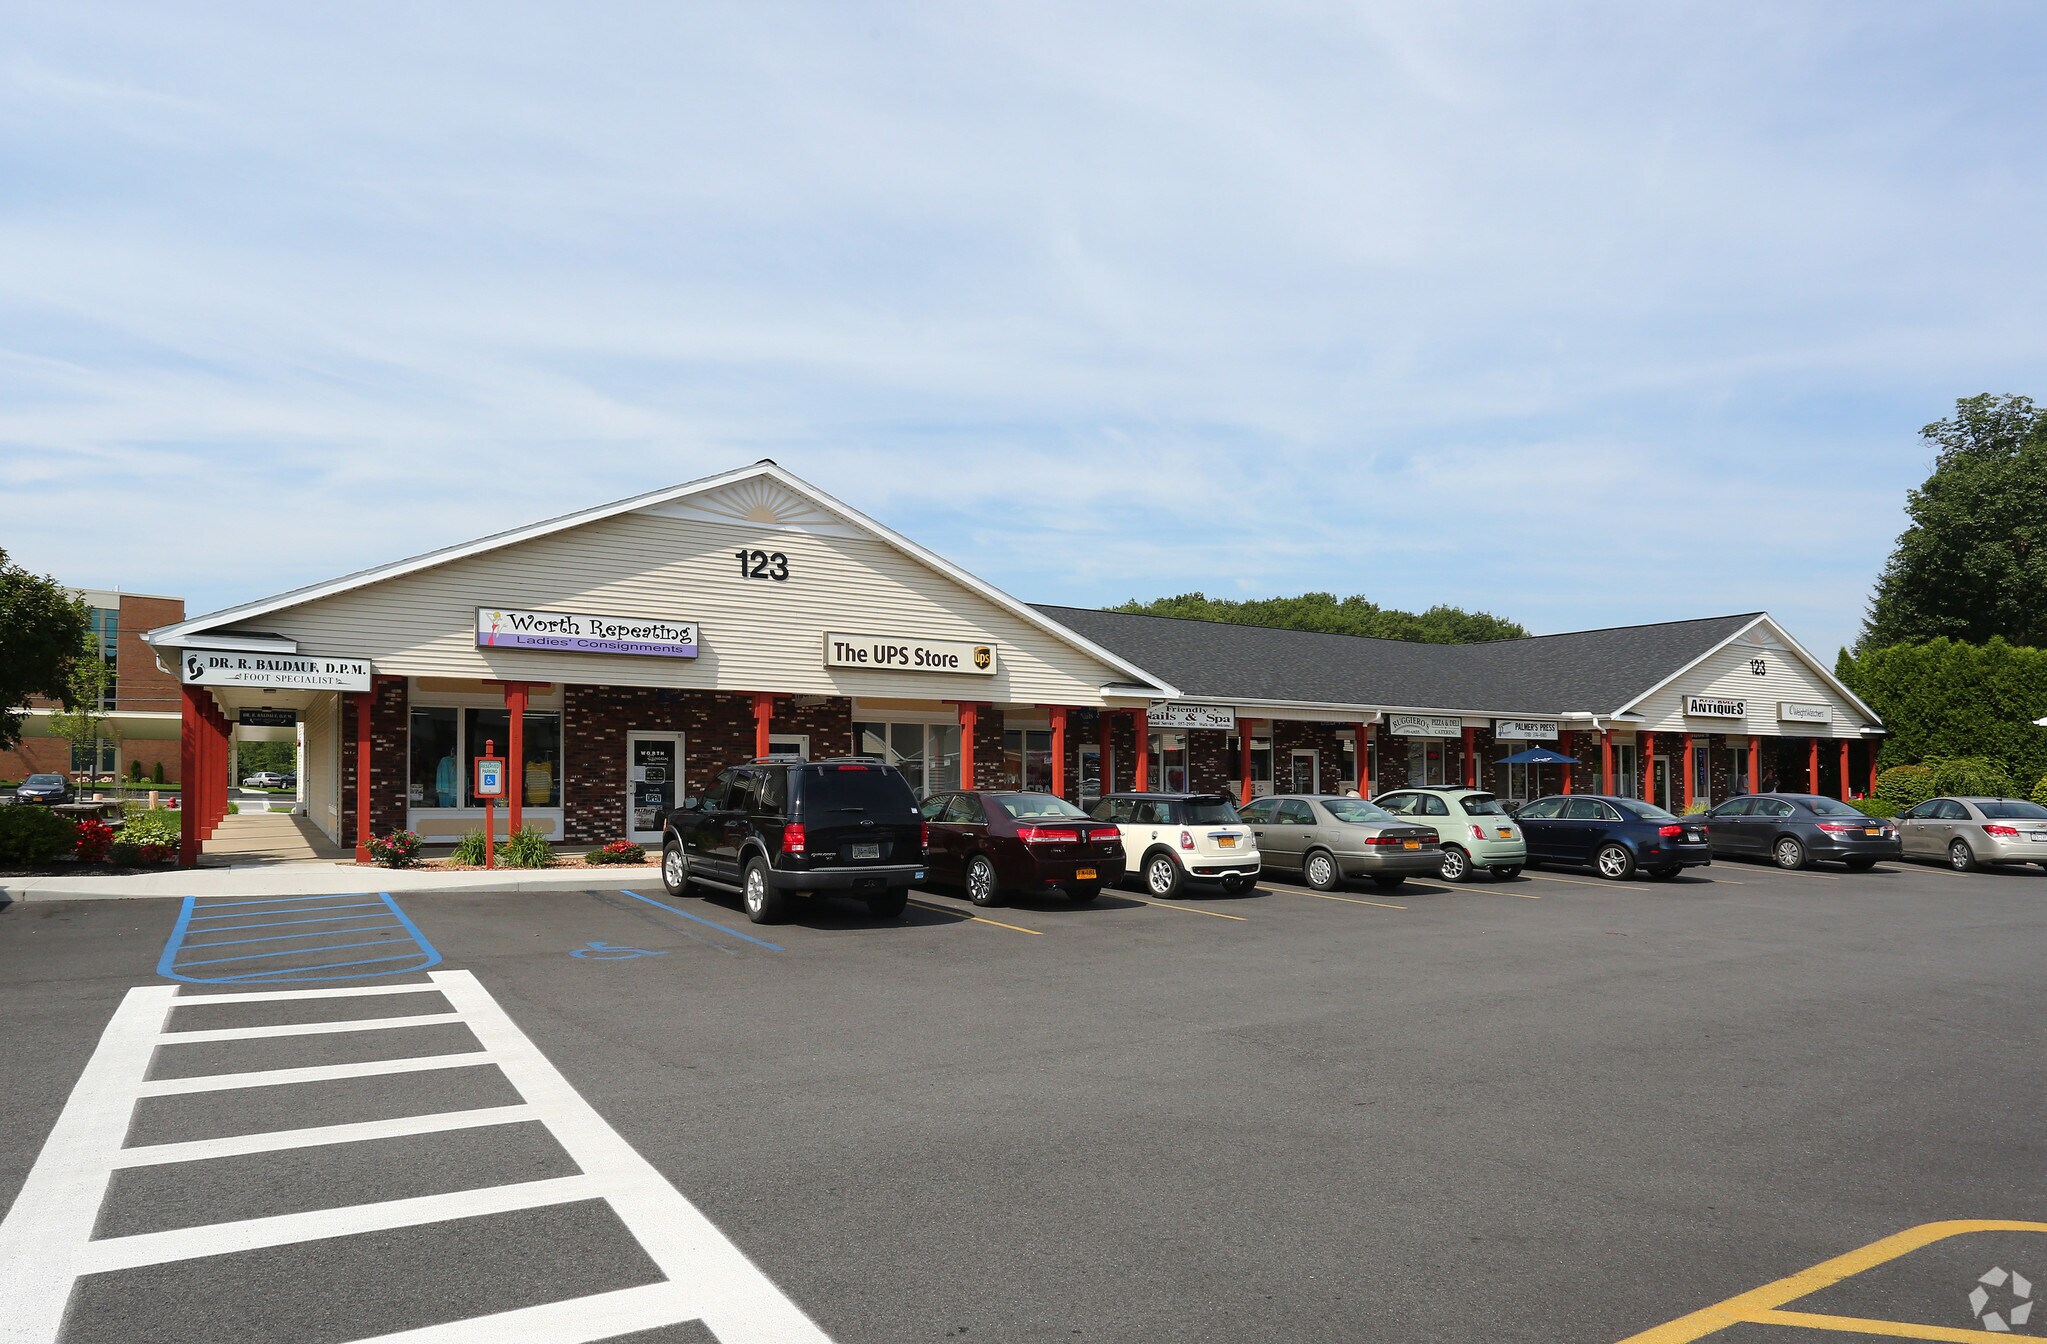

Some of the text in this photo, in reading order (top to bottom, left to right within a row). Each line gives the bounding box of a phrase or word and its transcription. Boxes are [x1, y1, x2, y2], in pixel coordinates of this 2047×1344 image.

[735, 550, 789, 581] 123
[507, 613, 692, 644] Worth Repeating
[516, 636, 683, 653] Ladies' Consignments
[834, 642, 959, 668] The UPS Store
[974, 652, 990, 667] ups
[209, 657, 366, 675] DR. R. BALDAUF, D.P.M.
[1750, 659, 1766, 676] 123
[244, 673, 334, 685] FOOT SPECIALIST
[1166, 706, 1208, 714] Friendly
[1690, 699, 1744, 715] ANTIQUES
[1185, 713, 1197, 721] &
[1206, 714, 1231, 723] Spa
[1449, 719, 1460, 727] DELI
[1515, 722, 1556, 731] PALMER'S PRESS
